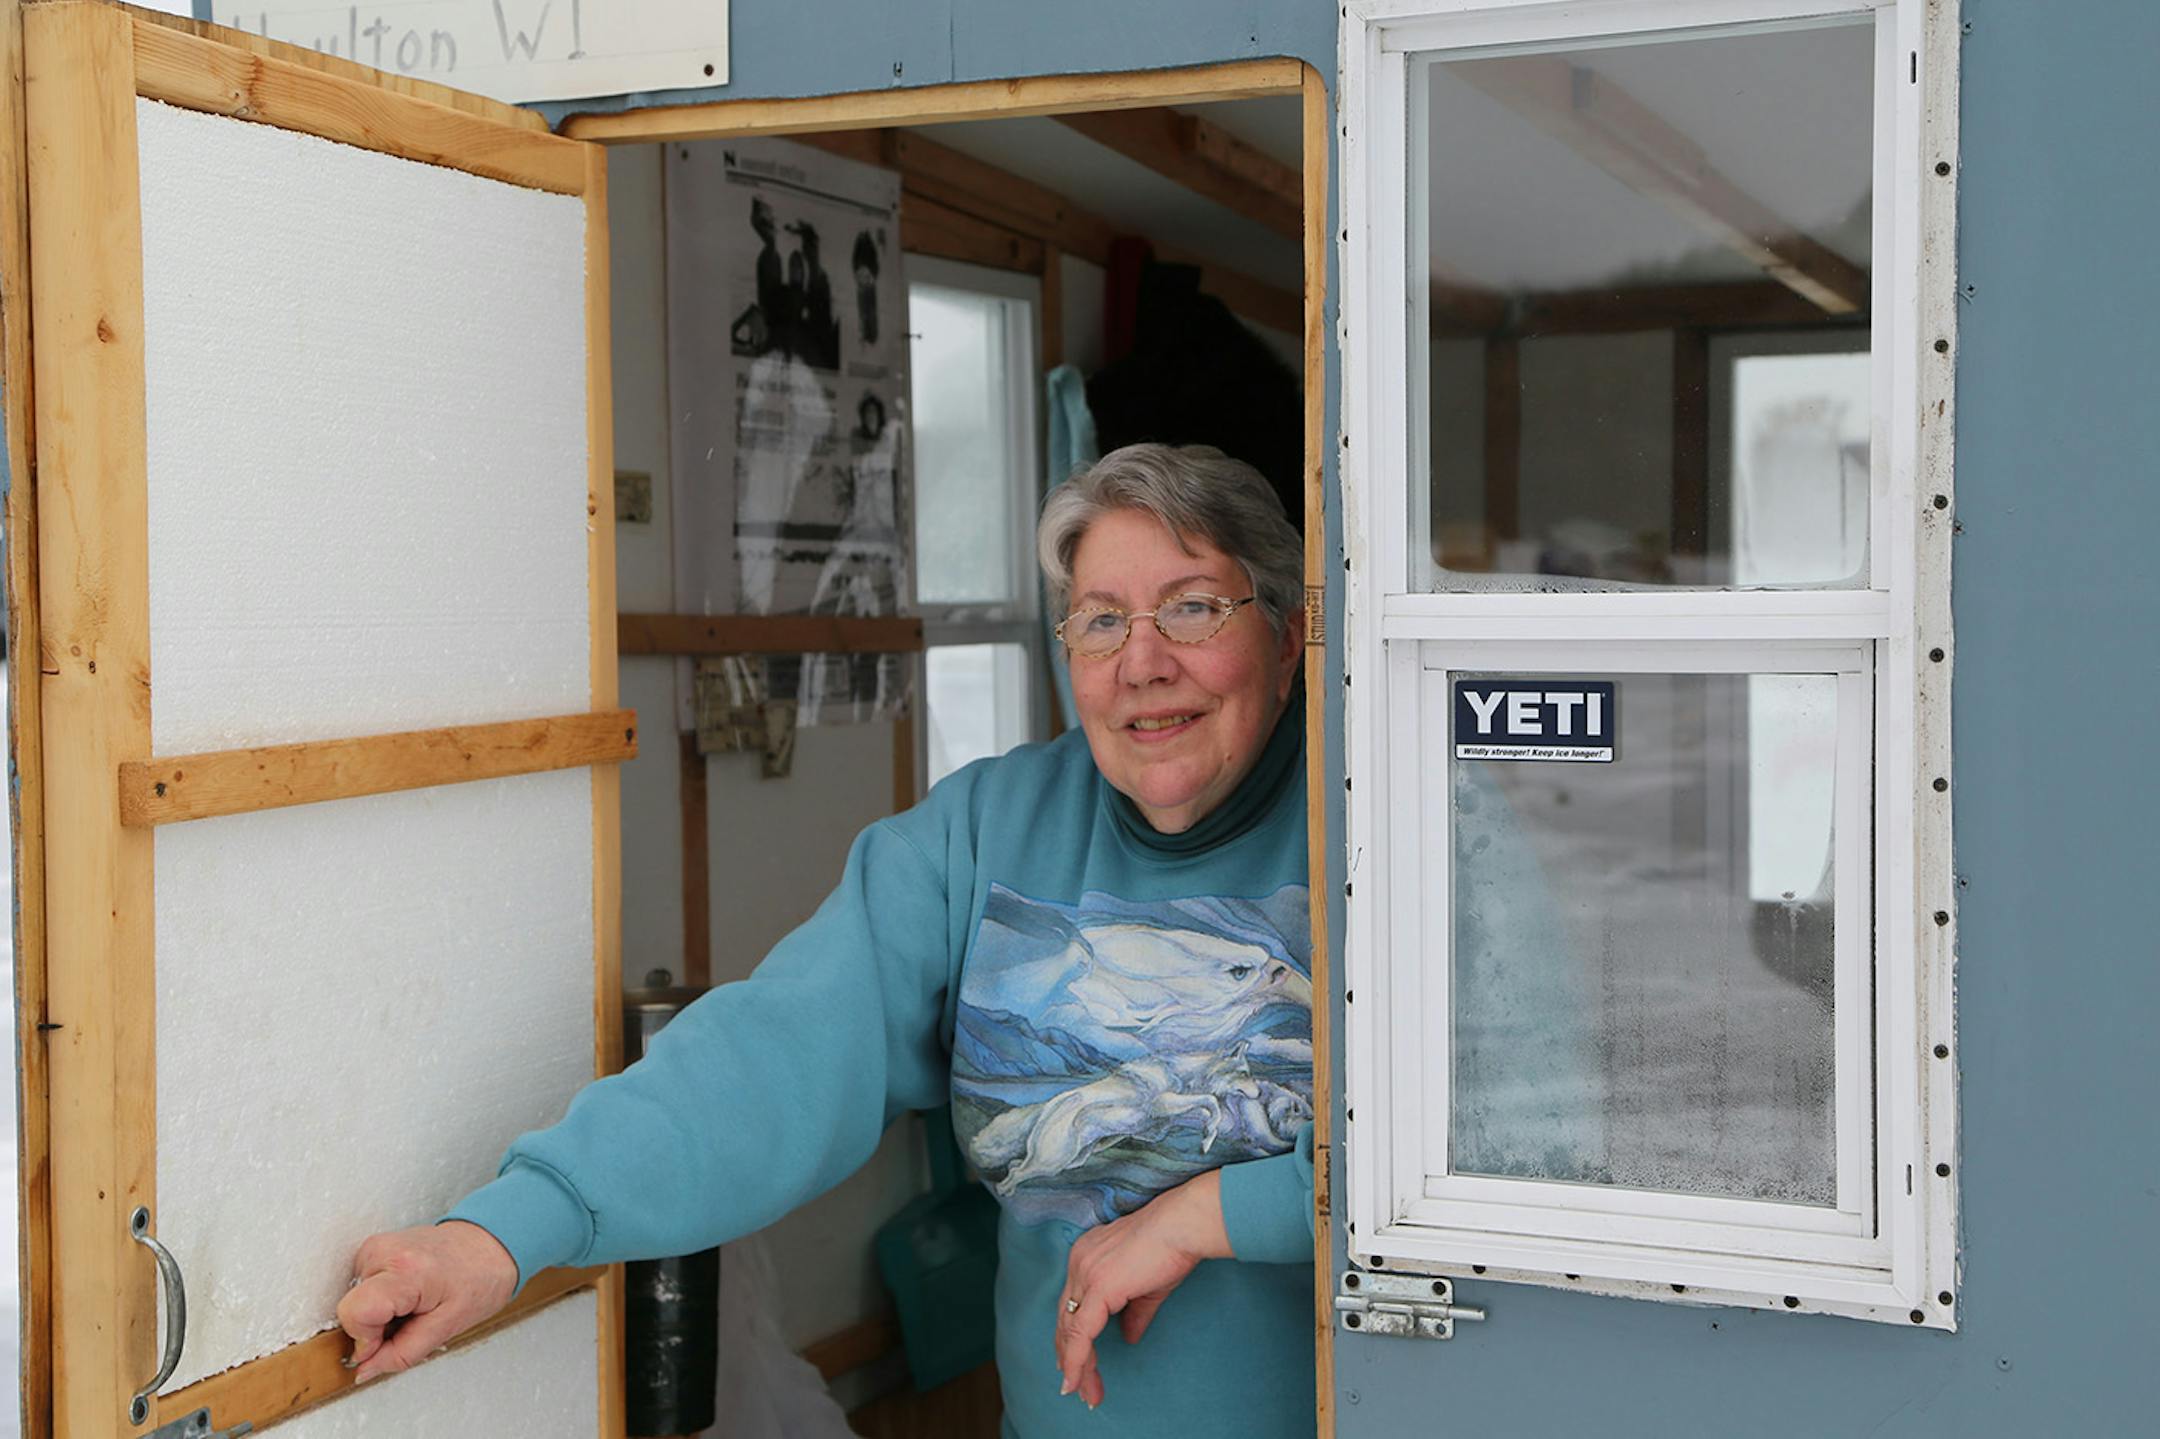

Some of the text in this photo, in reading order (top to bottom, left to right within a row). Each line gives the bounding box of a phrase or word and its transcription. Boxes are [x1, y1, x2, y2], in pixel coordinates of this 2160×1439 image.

[233, 6, 457, 73] lton
[1463, 690, 1602, 736] YETI
[1463, 747, 1489, 757] Wildly
[1532, 749, 1553, 758] Keep
